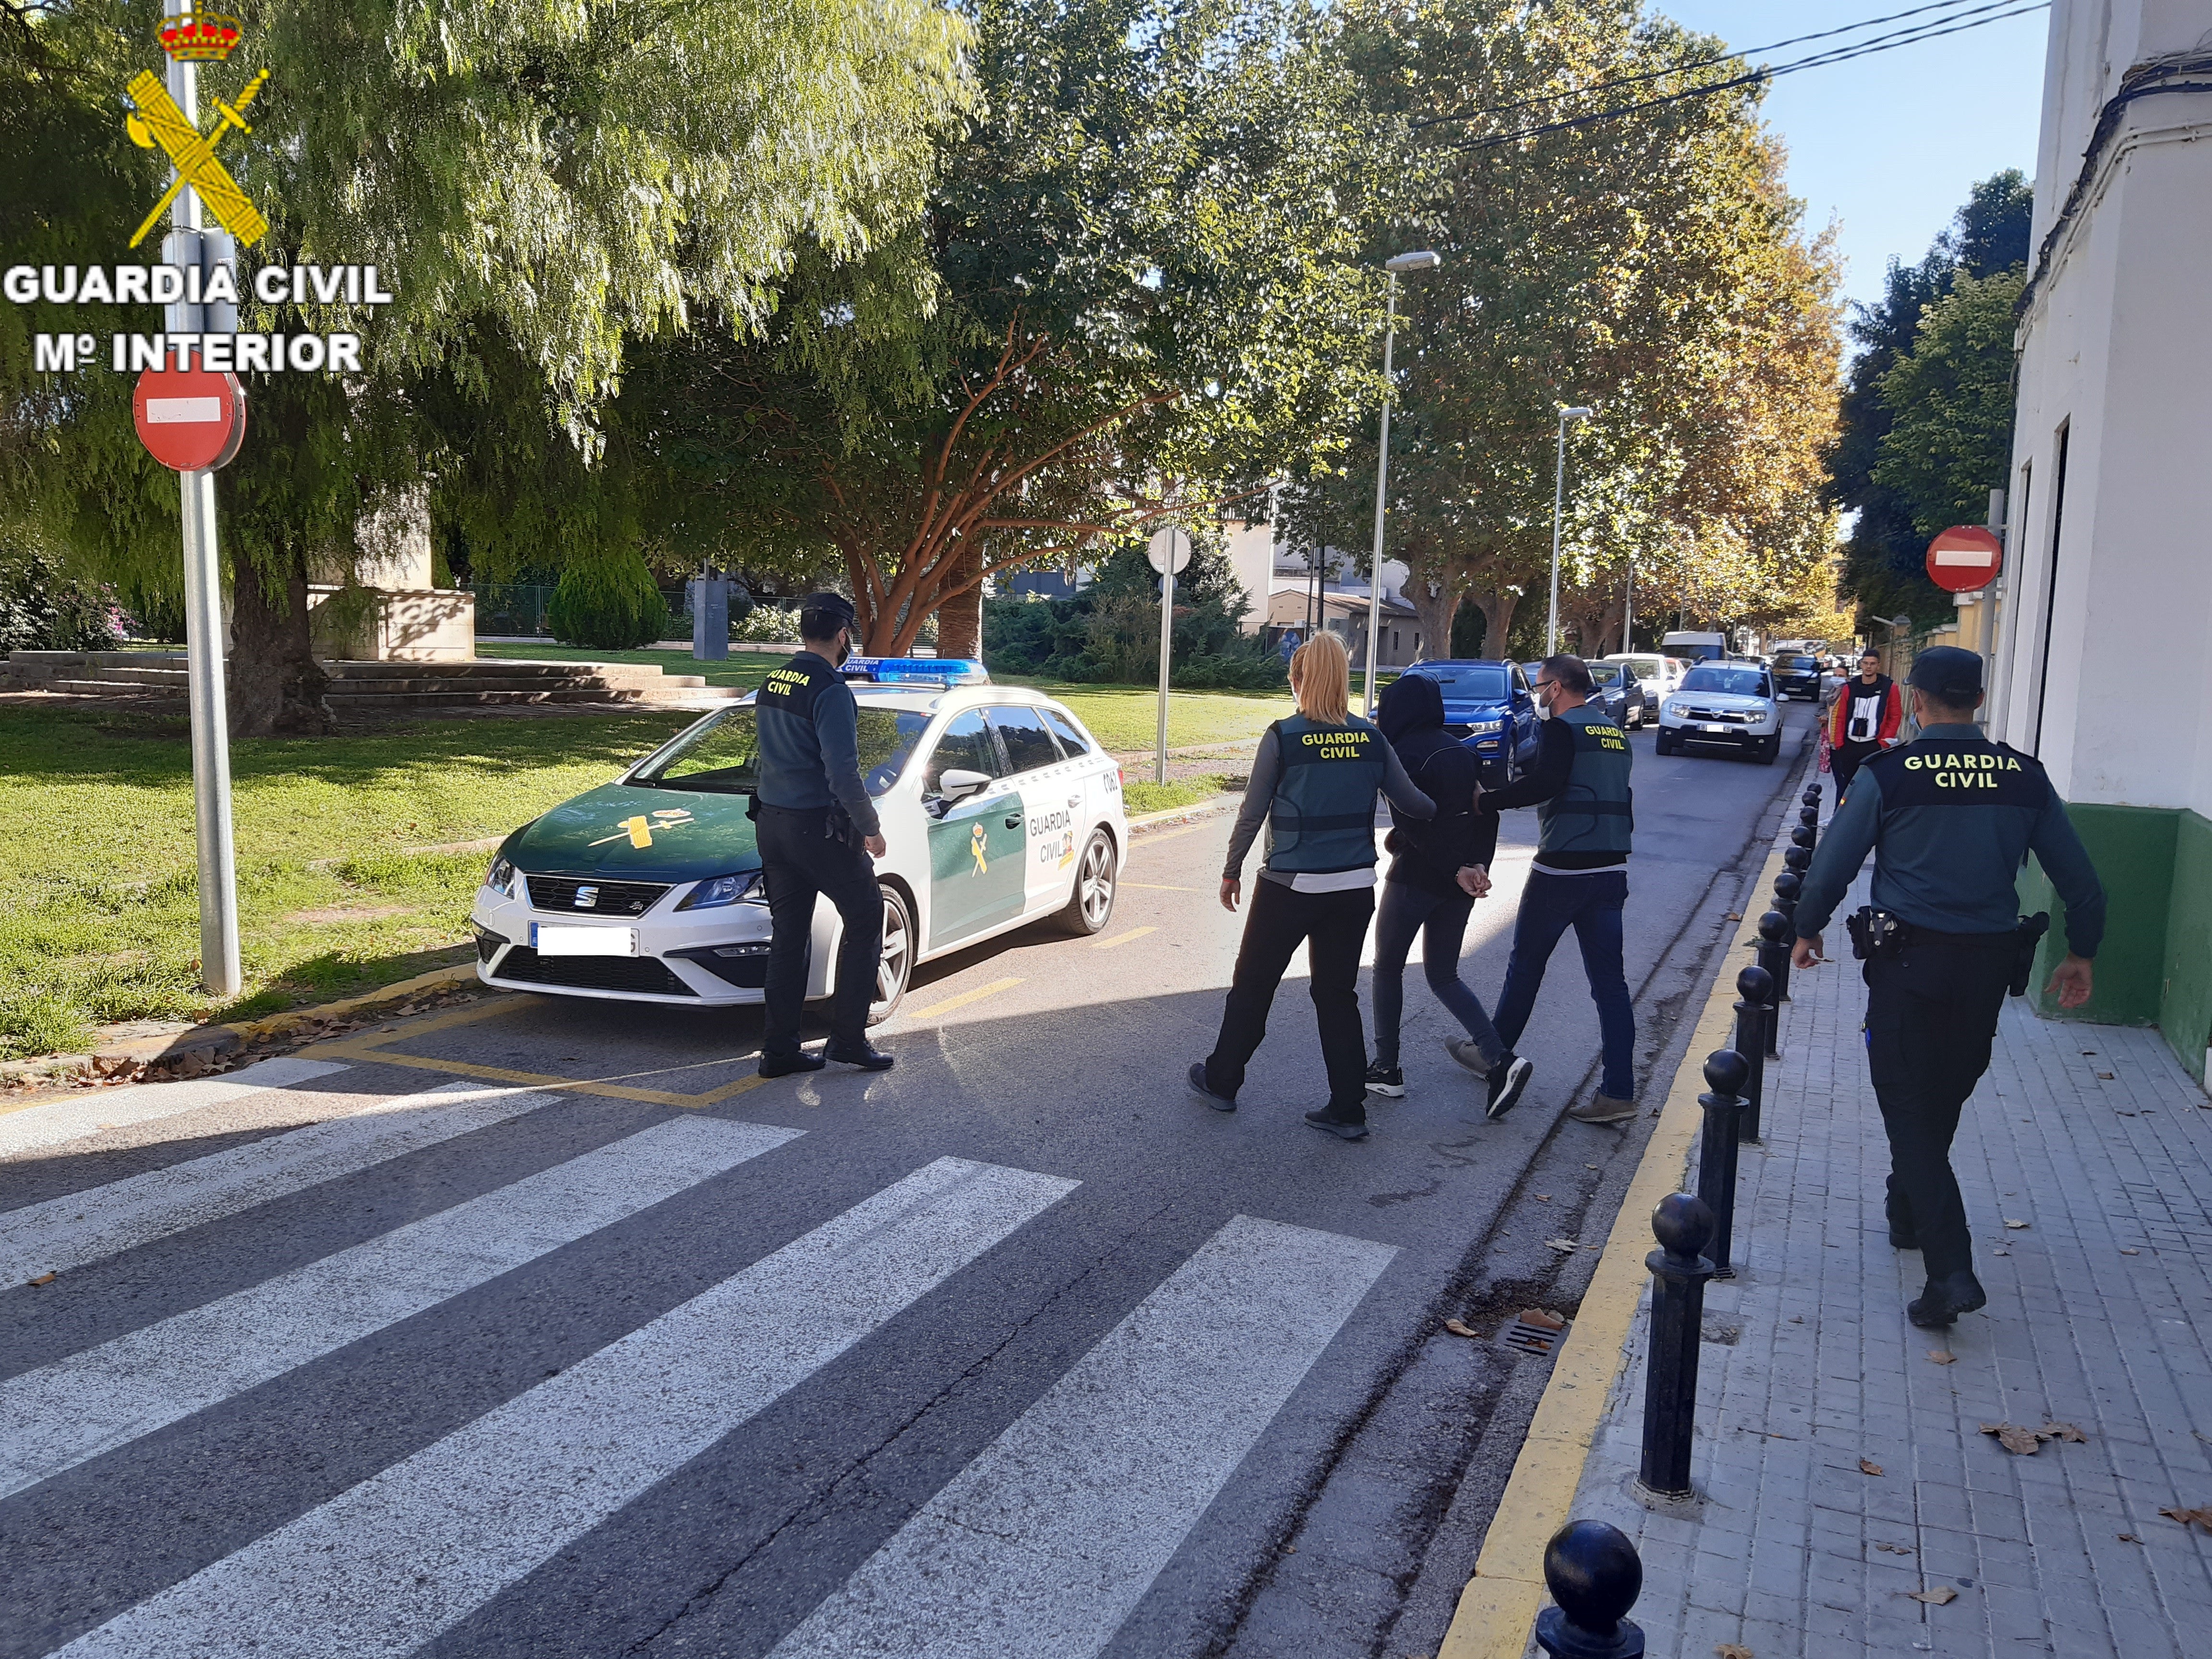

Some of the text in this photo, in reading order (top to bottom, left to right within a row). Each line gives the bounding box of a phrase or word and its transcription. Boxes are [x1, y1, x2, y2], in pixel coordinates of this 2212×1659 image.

[768, 681, 792, 696] CIVIL
[1301, 732, 1370, 745] GUARDIA
[1601, 738, 1625, 749] CIVIL
[1320, 746, 1360, 758] CIVIL
[1904, 754, 2022, 771] GUARDIA
[1935, 772, 1997, 788] CIVIL
[1030, 809, 1071, 837] GUARDIA
[1040, 841, 1062, 863] CIVIL
